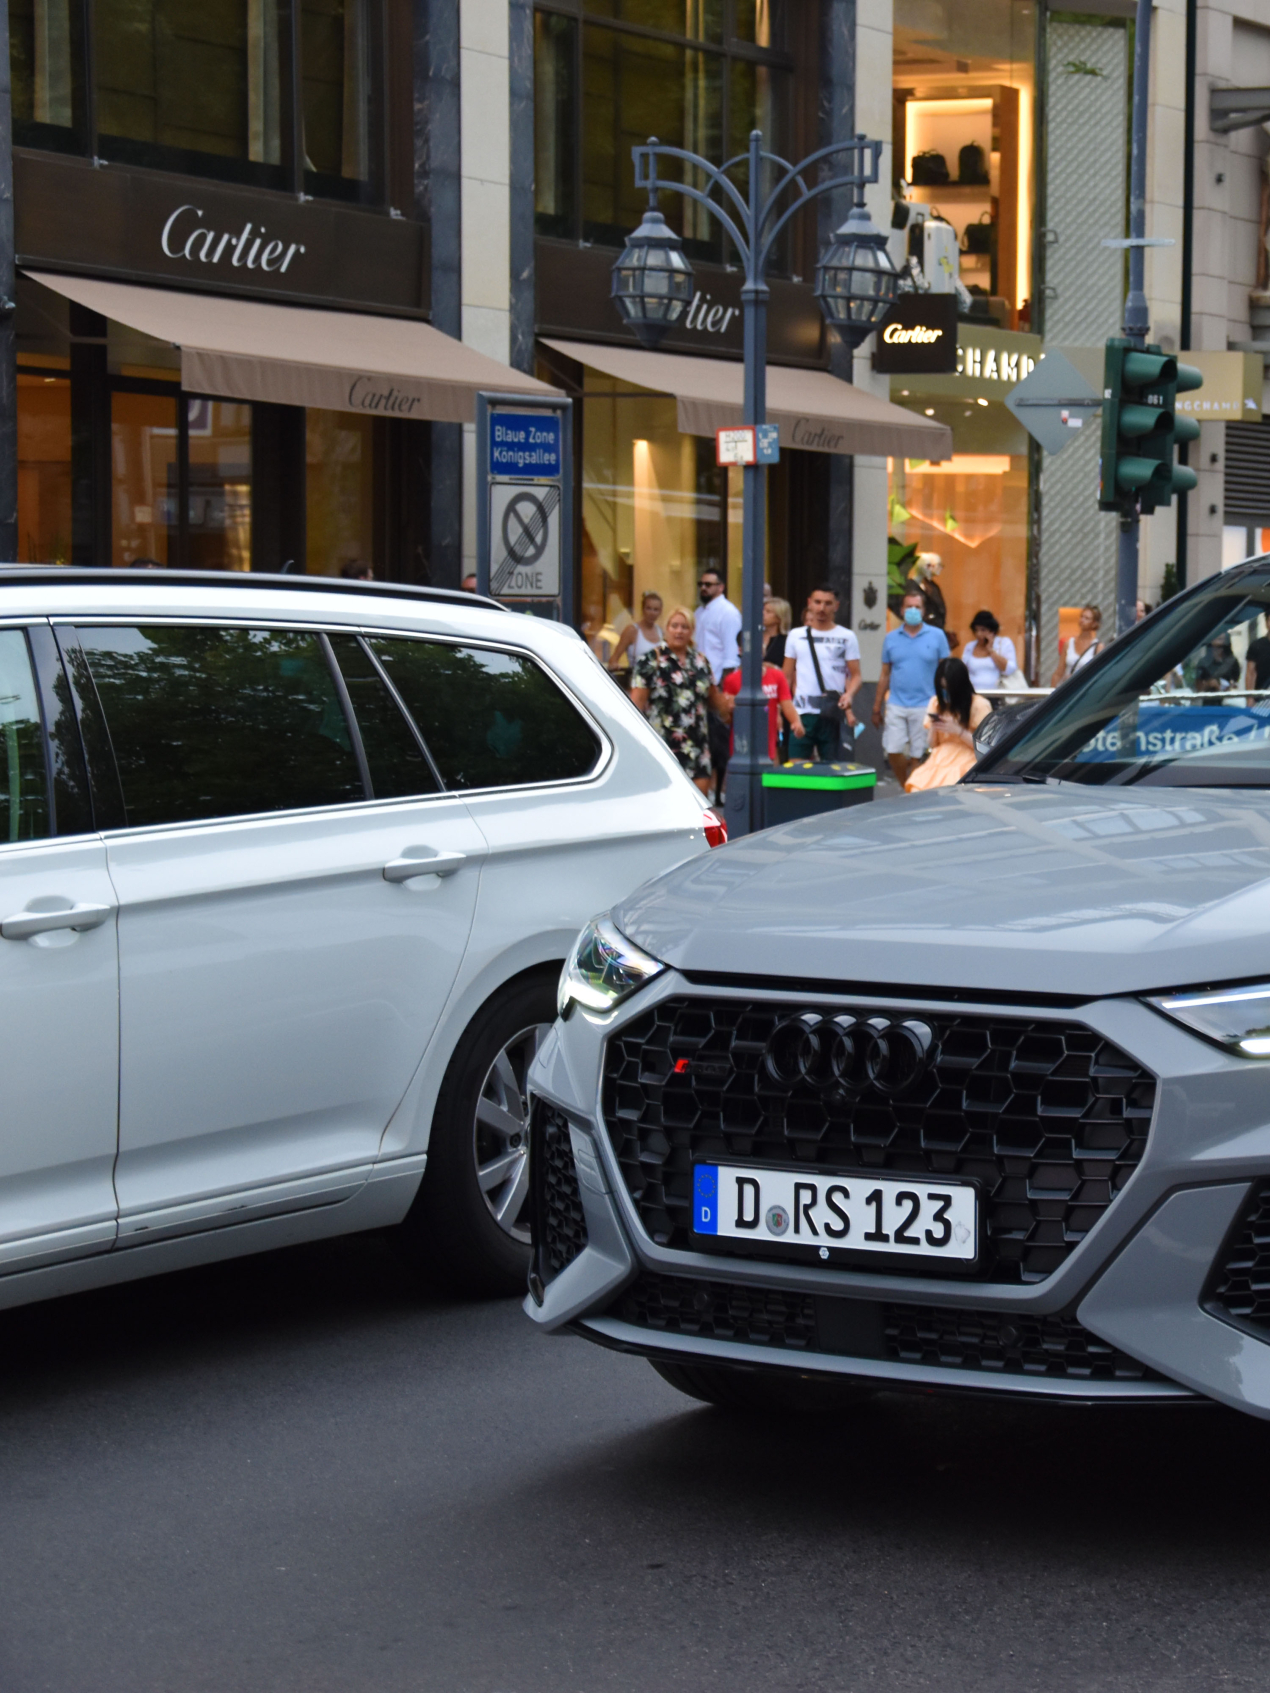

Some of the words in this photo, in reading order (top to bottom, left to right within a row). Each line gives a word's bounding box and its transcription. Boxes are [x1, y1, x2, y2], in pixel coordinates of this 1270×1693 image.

[161, 204, 305, 273] Cartier
[685, 290, 740, 333] tier
[883, 323, 943, 344] Cartier
[348, 375, 421, 413] Cartier
[494, 426, 526, 443] Blaue
[529, 427, 555, 444] Zone
[791, 417, 844, 449] Cartier
[493, 447, 556, 467] Königsallee
[507, 572, 543, 590] ZONE
[701, 1206, 711, 1223] D
[735, 1176, 760, 1230] D
[794, 1181, 851, 1239] RS
[864, 1188, 952, 1247] 123
